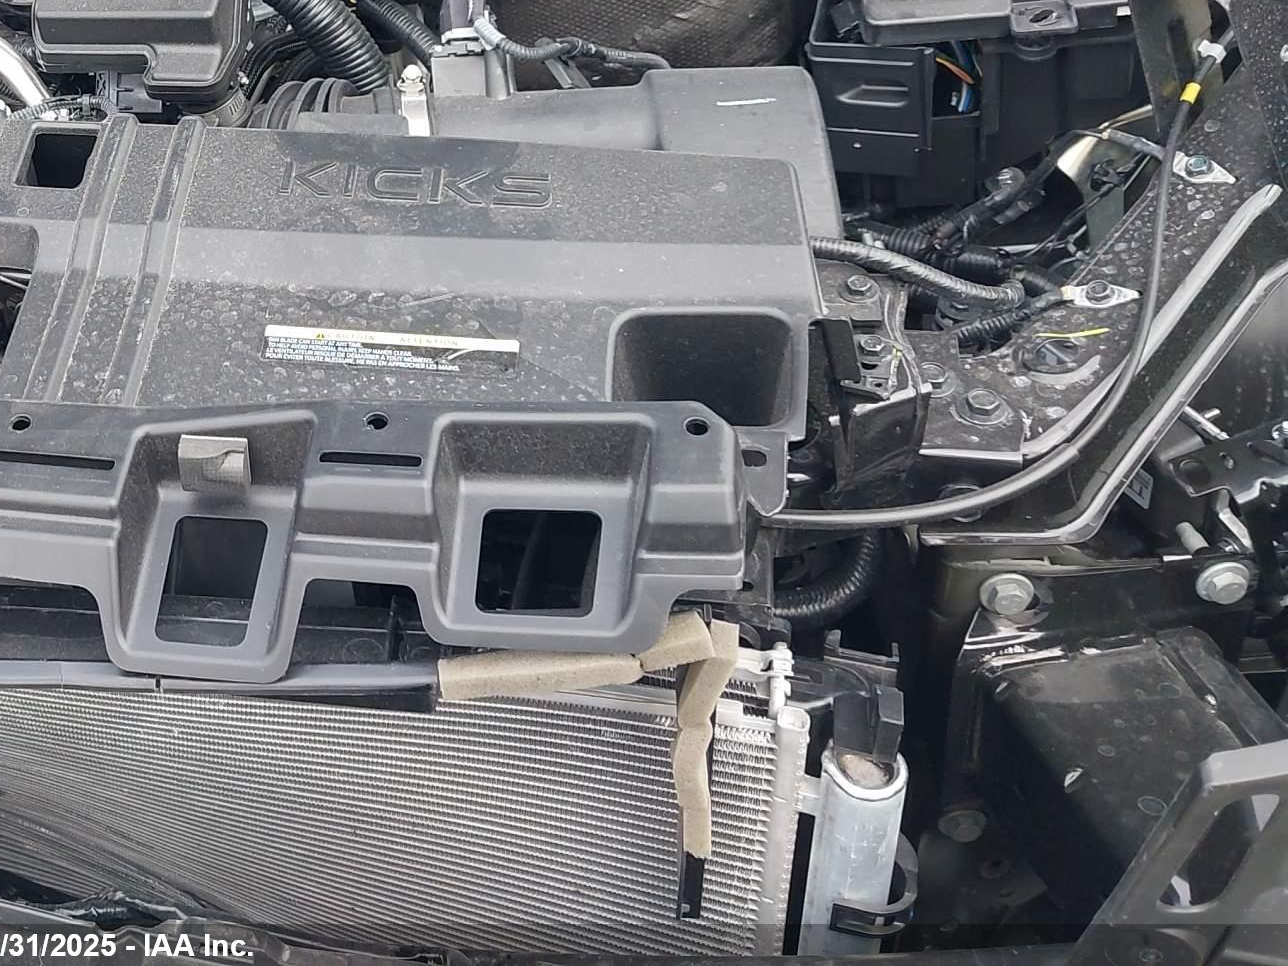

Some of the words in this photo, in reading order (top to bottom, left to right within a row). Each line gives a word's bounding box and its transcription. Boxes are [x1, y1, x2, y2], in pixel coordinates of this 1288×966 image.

[278, 159, 553, 209] KICKS
[327, 333, 375, 341] CAUTION
[399, 337, 458, 346] ATTENTION
